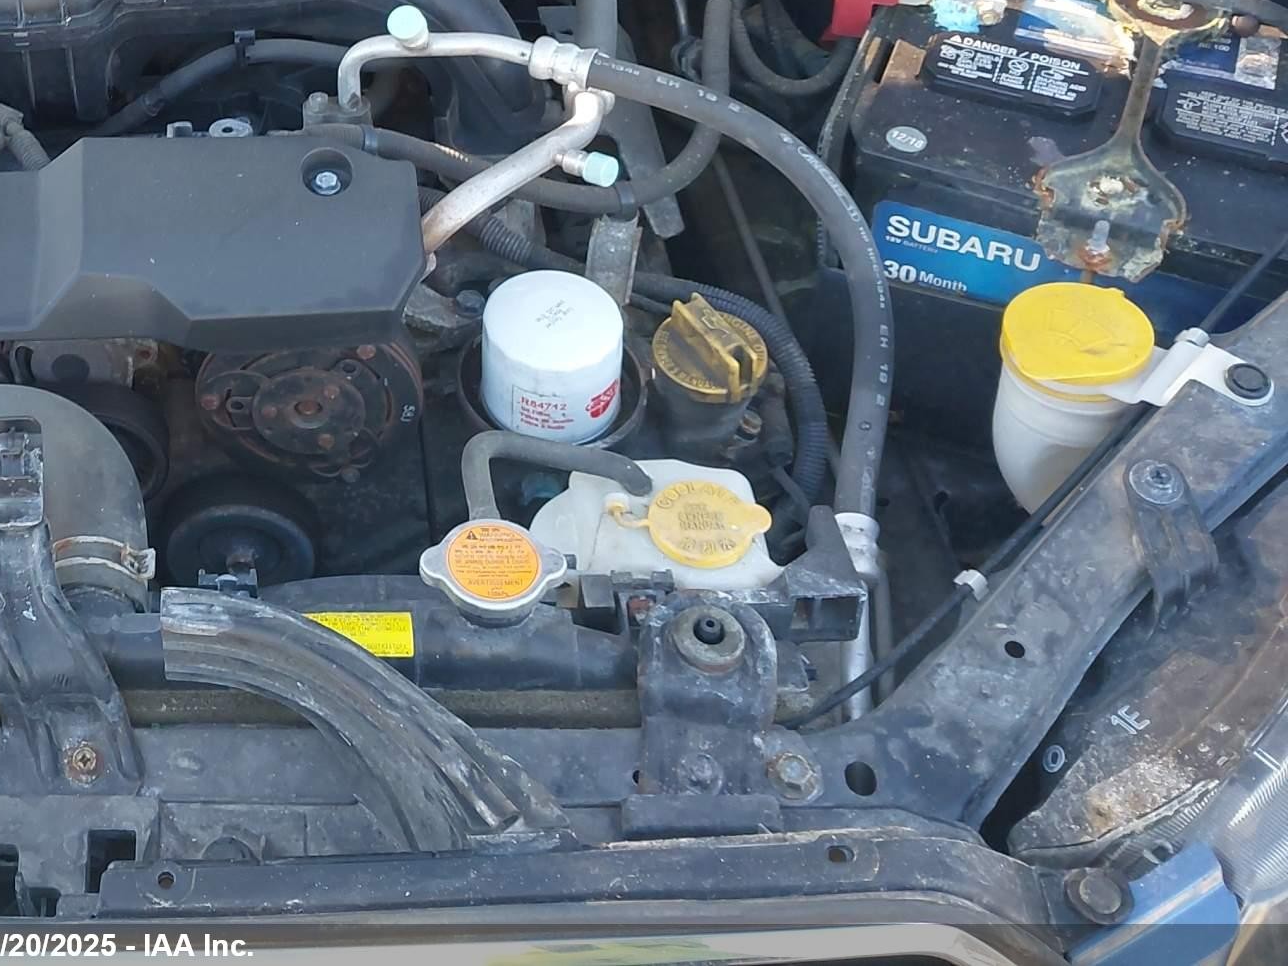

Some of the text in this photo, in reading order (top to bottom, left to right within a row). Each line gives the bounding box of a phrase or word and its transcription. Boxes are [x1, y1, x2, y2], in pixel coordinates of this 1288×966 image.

[963, 38, 1017, 55] DANGER
[1030, 52, 1081, 71] POISON
[886, 214, 1041, 272] SUBARU
[883, 259, 968, 293] 30 Month
